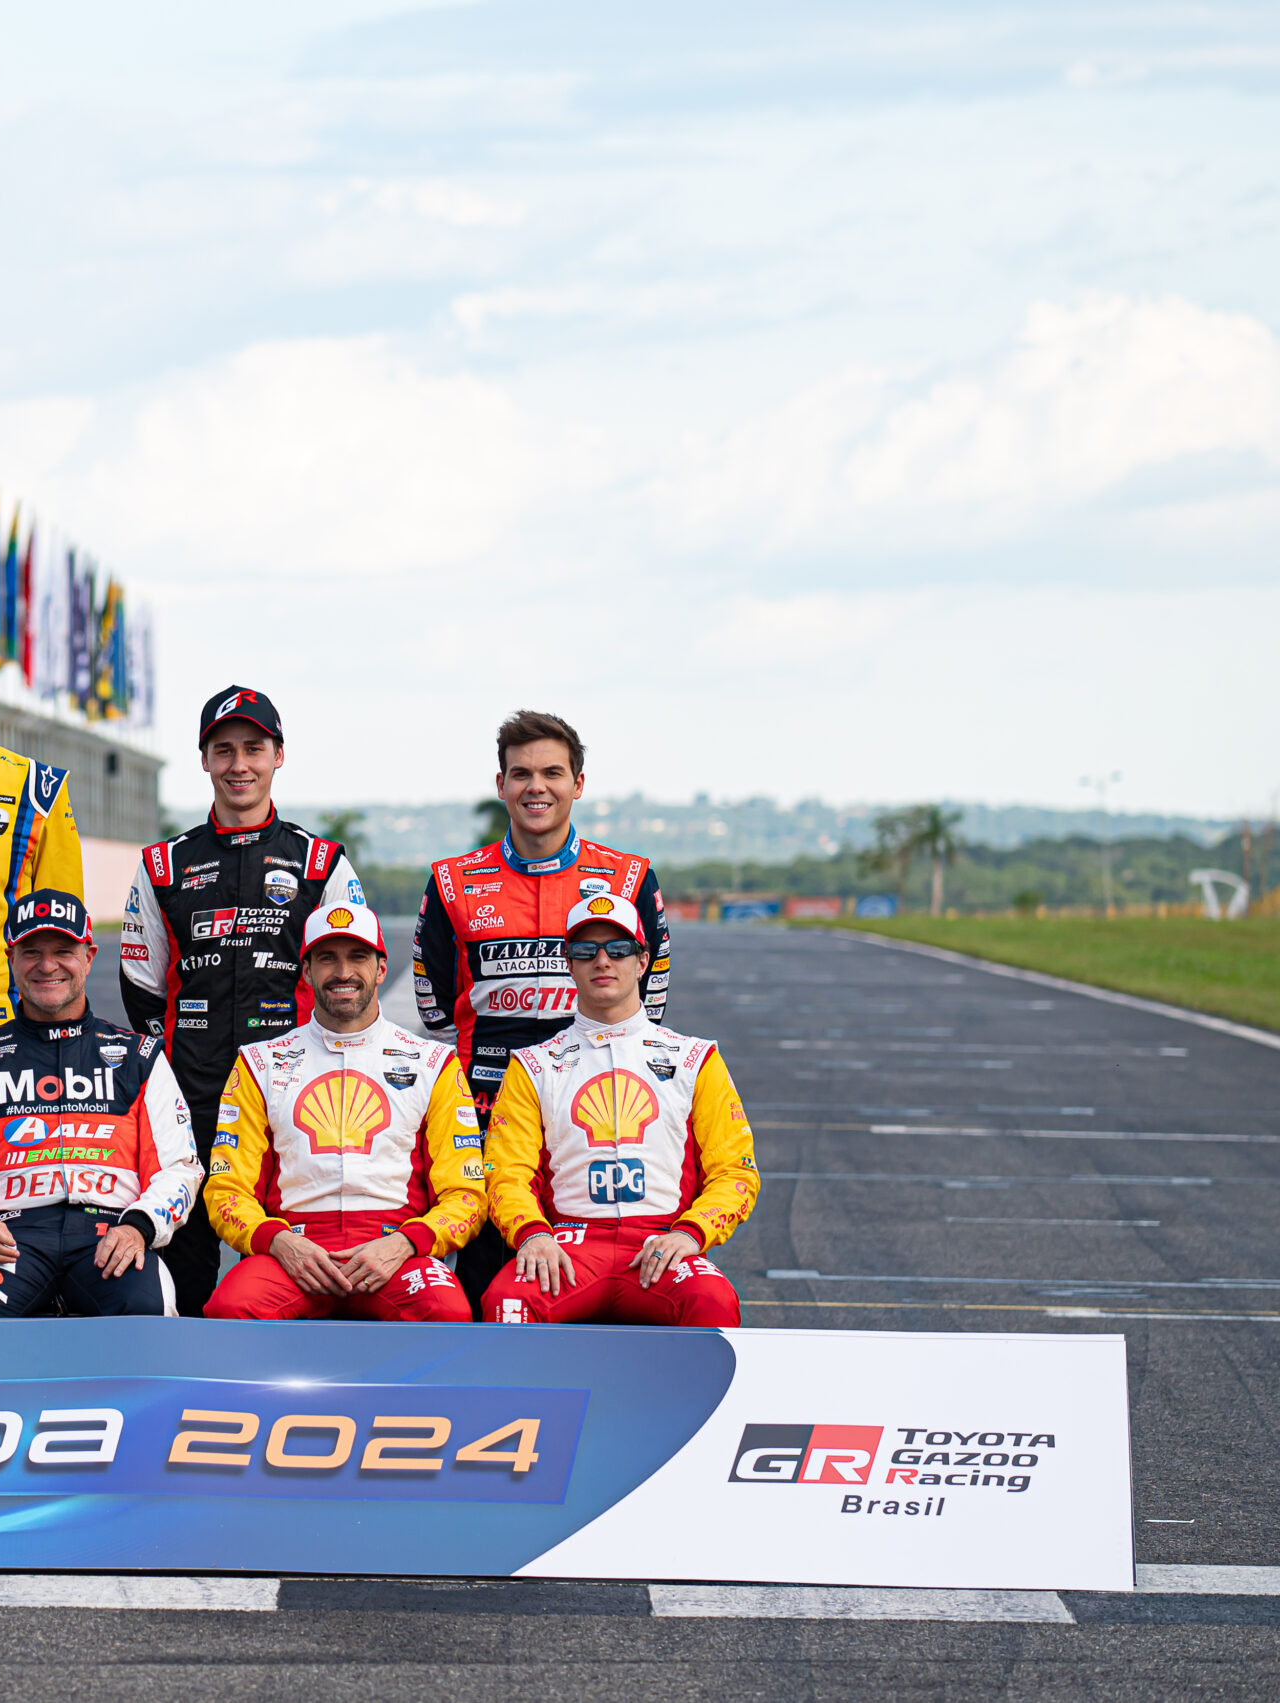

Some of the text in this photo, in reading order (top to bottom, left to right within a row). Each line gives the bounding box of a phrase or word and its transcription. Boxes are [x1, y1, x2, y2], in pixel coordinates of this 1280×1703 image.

[215, 690, 258, 720] GR
[151, 846, 164, 878] sparco
[438, 864, 456, 903] sparco
[621, 860, 642, 899] sparco
[17, 900, 77, 923] Mobil
[237, 916, 284, 925] GAZOO
[239, 907, 290, 917] TOYOTA
[192, 918, 233, 939] GR
[236, 925, 281, 935] Racing
[468, 915, 505, 929] KRONA
[220, 937, 252, 947] Brasil
[486, 940, 566, 960] TAMBA
[121, 947, 148, 957] ENSO
[266, 960, 298, 971] SERVICE
[488, 987, 578, 1011] LOCTIT
[178, 1018, 208, 1029] sparco
[48, 1026, 82, 1040] Mobil
[476, 1046, 507, 1057] sparco
[6, 1103, 109, 1116] #MovimentoMobil
[215, 1133, 237, 1147] nata
[455, 1137, 481, 1149] Rena
[26, 1146, 115, 1163] ENERGY
[211, 1161, 231, 1173] Cain
[463, 1165, 484, 1177] McCa
[5, 1170, 118, 1200] DENSO
[591, 1163, 643, 1202] PPG
[167, 1408, 541, 1474] 2024
[896, 1428, 1057, 1449] TOYOTA
[730, 1446, 869, 1483] GR
[890, 1448, 1040, 1467] GAZOO
[885, 1467, 1032, 1493] Racing
[840, 1493, 945, 1517] Brasil
